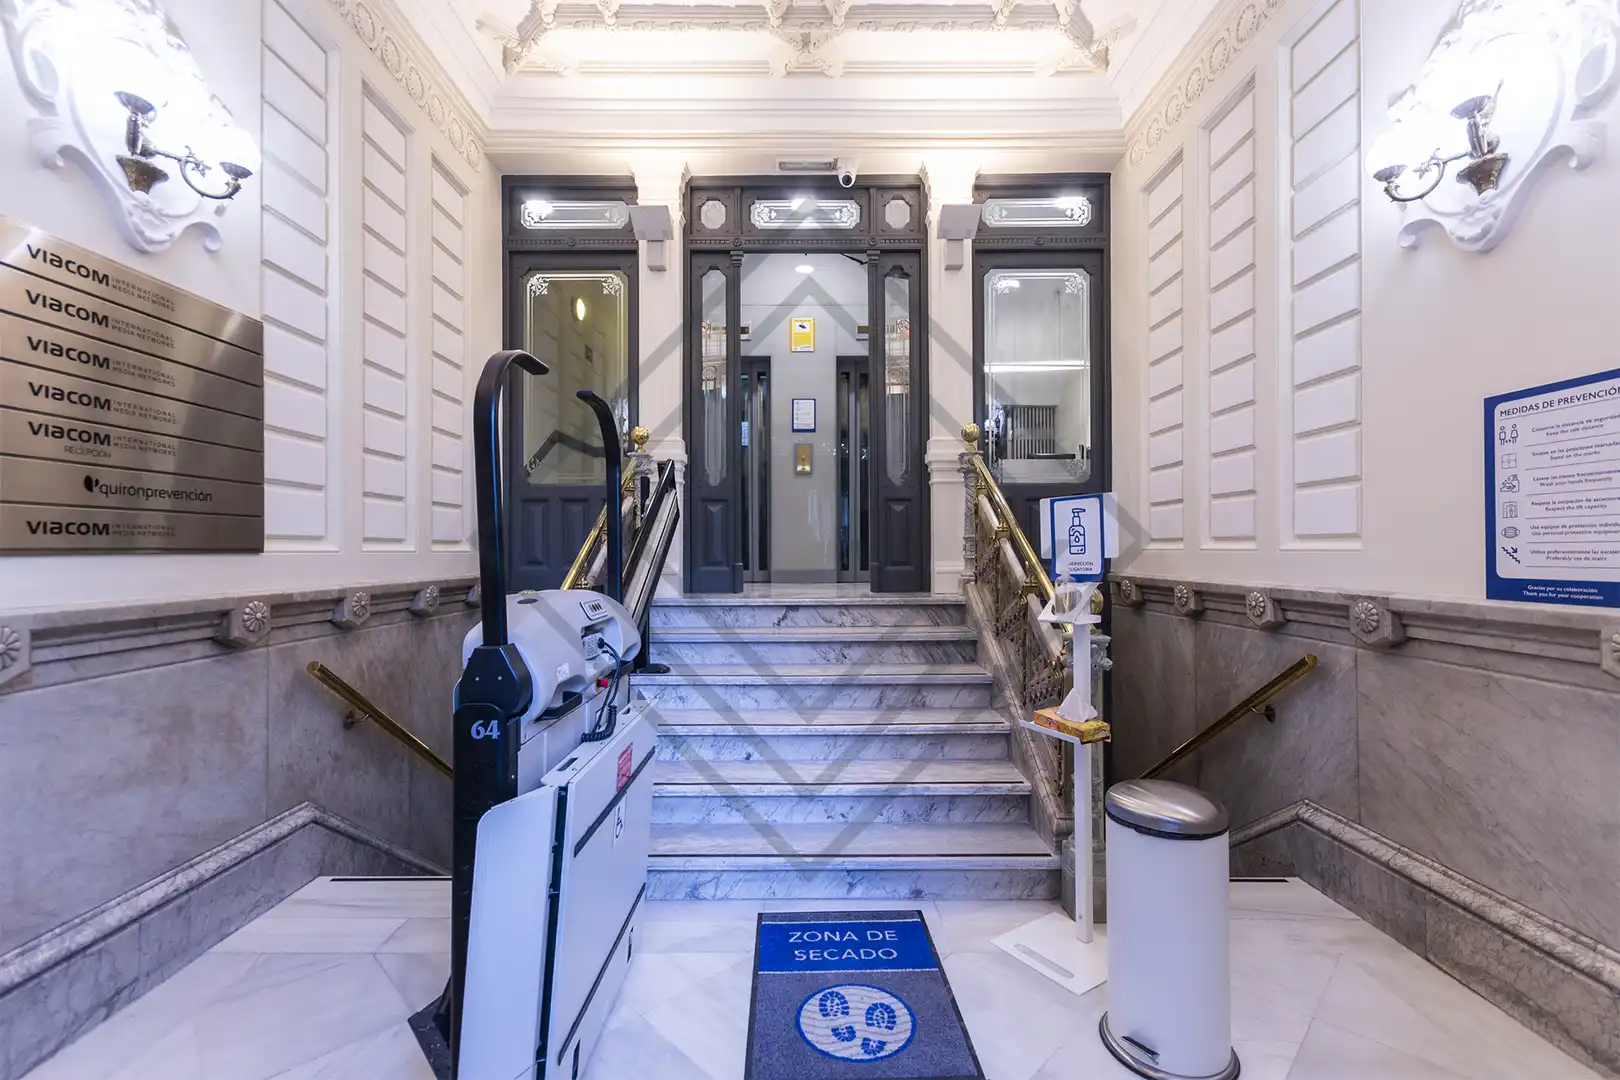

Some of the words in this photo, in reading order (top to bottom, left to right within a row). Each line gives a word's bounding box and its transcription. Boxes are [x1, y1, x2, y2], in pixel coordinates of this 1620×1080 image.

[112, 324, 135, 335] MEDIA
[112, 318, 174, 342] INTERNATIONAL
[113, 359, 174, 380] INTERNATIONAL
[113, 366, 135, 376] MEDIA
[114, 400, 175, 418] INTERNATIONAL
[1500, 403, 1540, 417] MEDIDAS
[1542, 400, 1555, 408] DE
[470, 720, 500, 739] 64
[789, 930, 859, 942] ZONA
[868, 930, 898, 941] DE
[794, 948, 898, 961] SECADO
